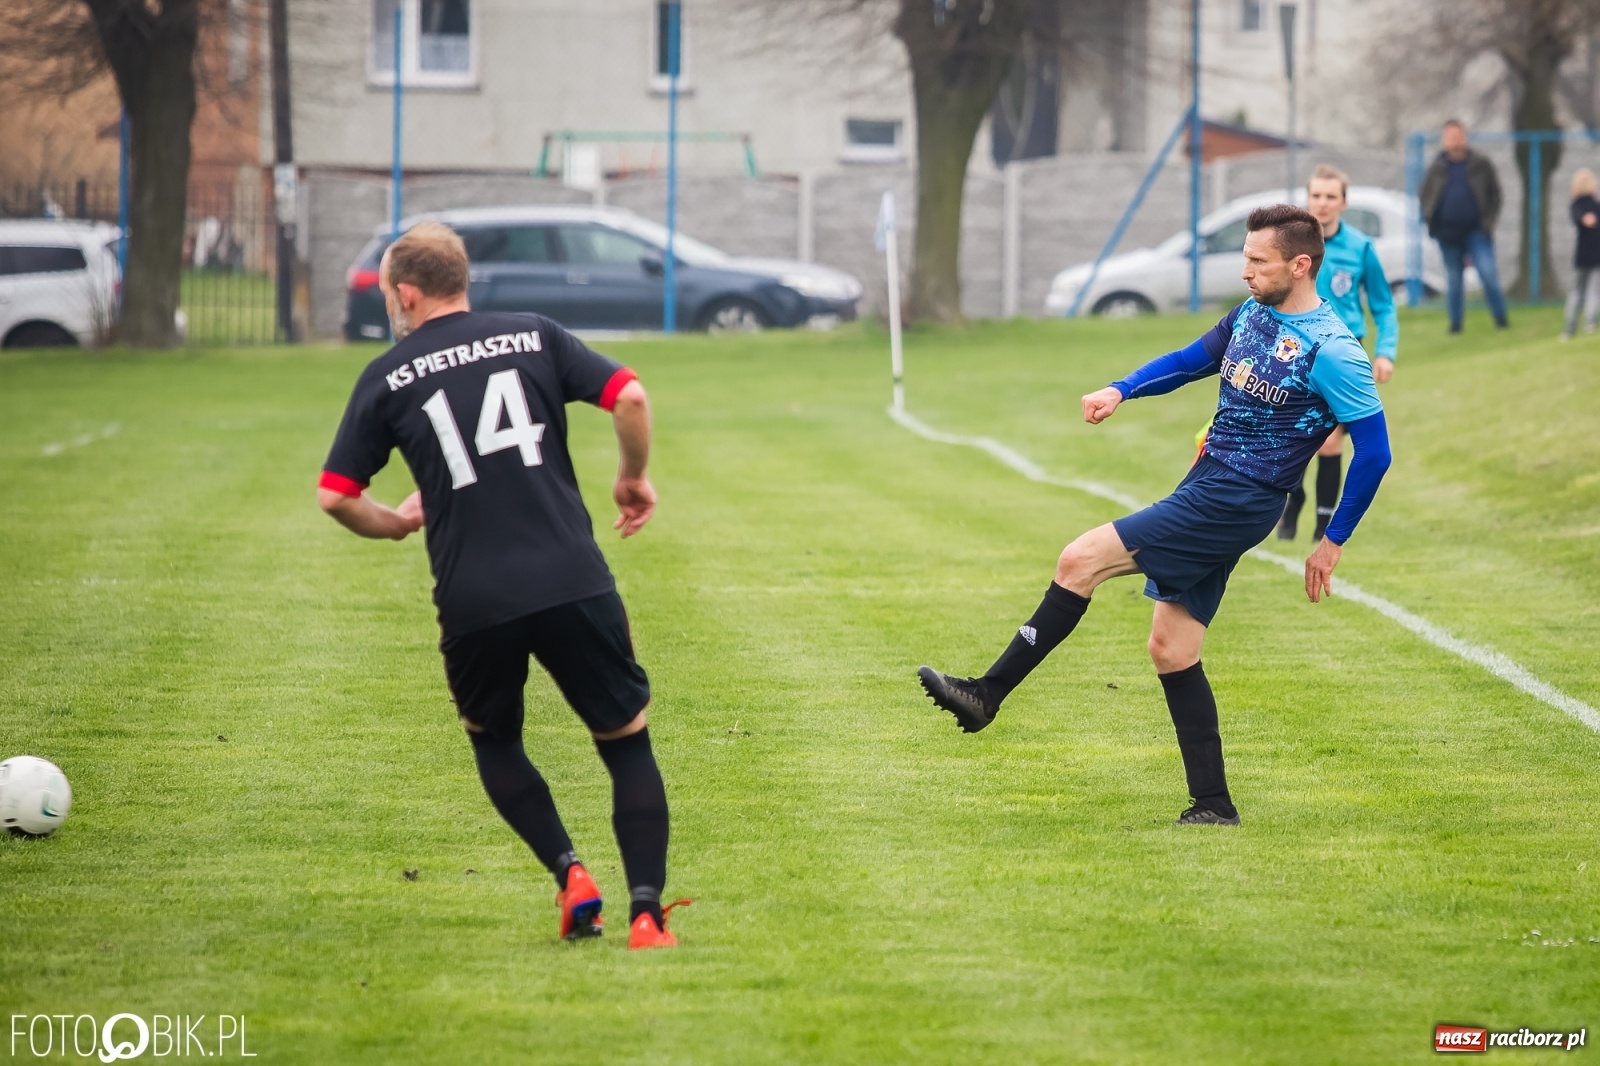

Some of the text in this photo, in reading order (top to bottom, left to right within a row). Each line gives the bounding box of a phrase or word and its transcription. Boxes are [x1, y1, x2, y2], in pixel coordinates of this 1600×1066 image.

[385, 330, 542, 392] KS PIETRASZYN
[421, 368, 546, 490] 14
